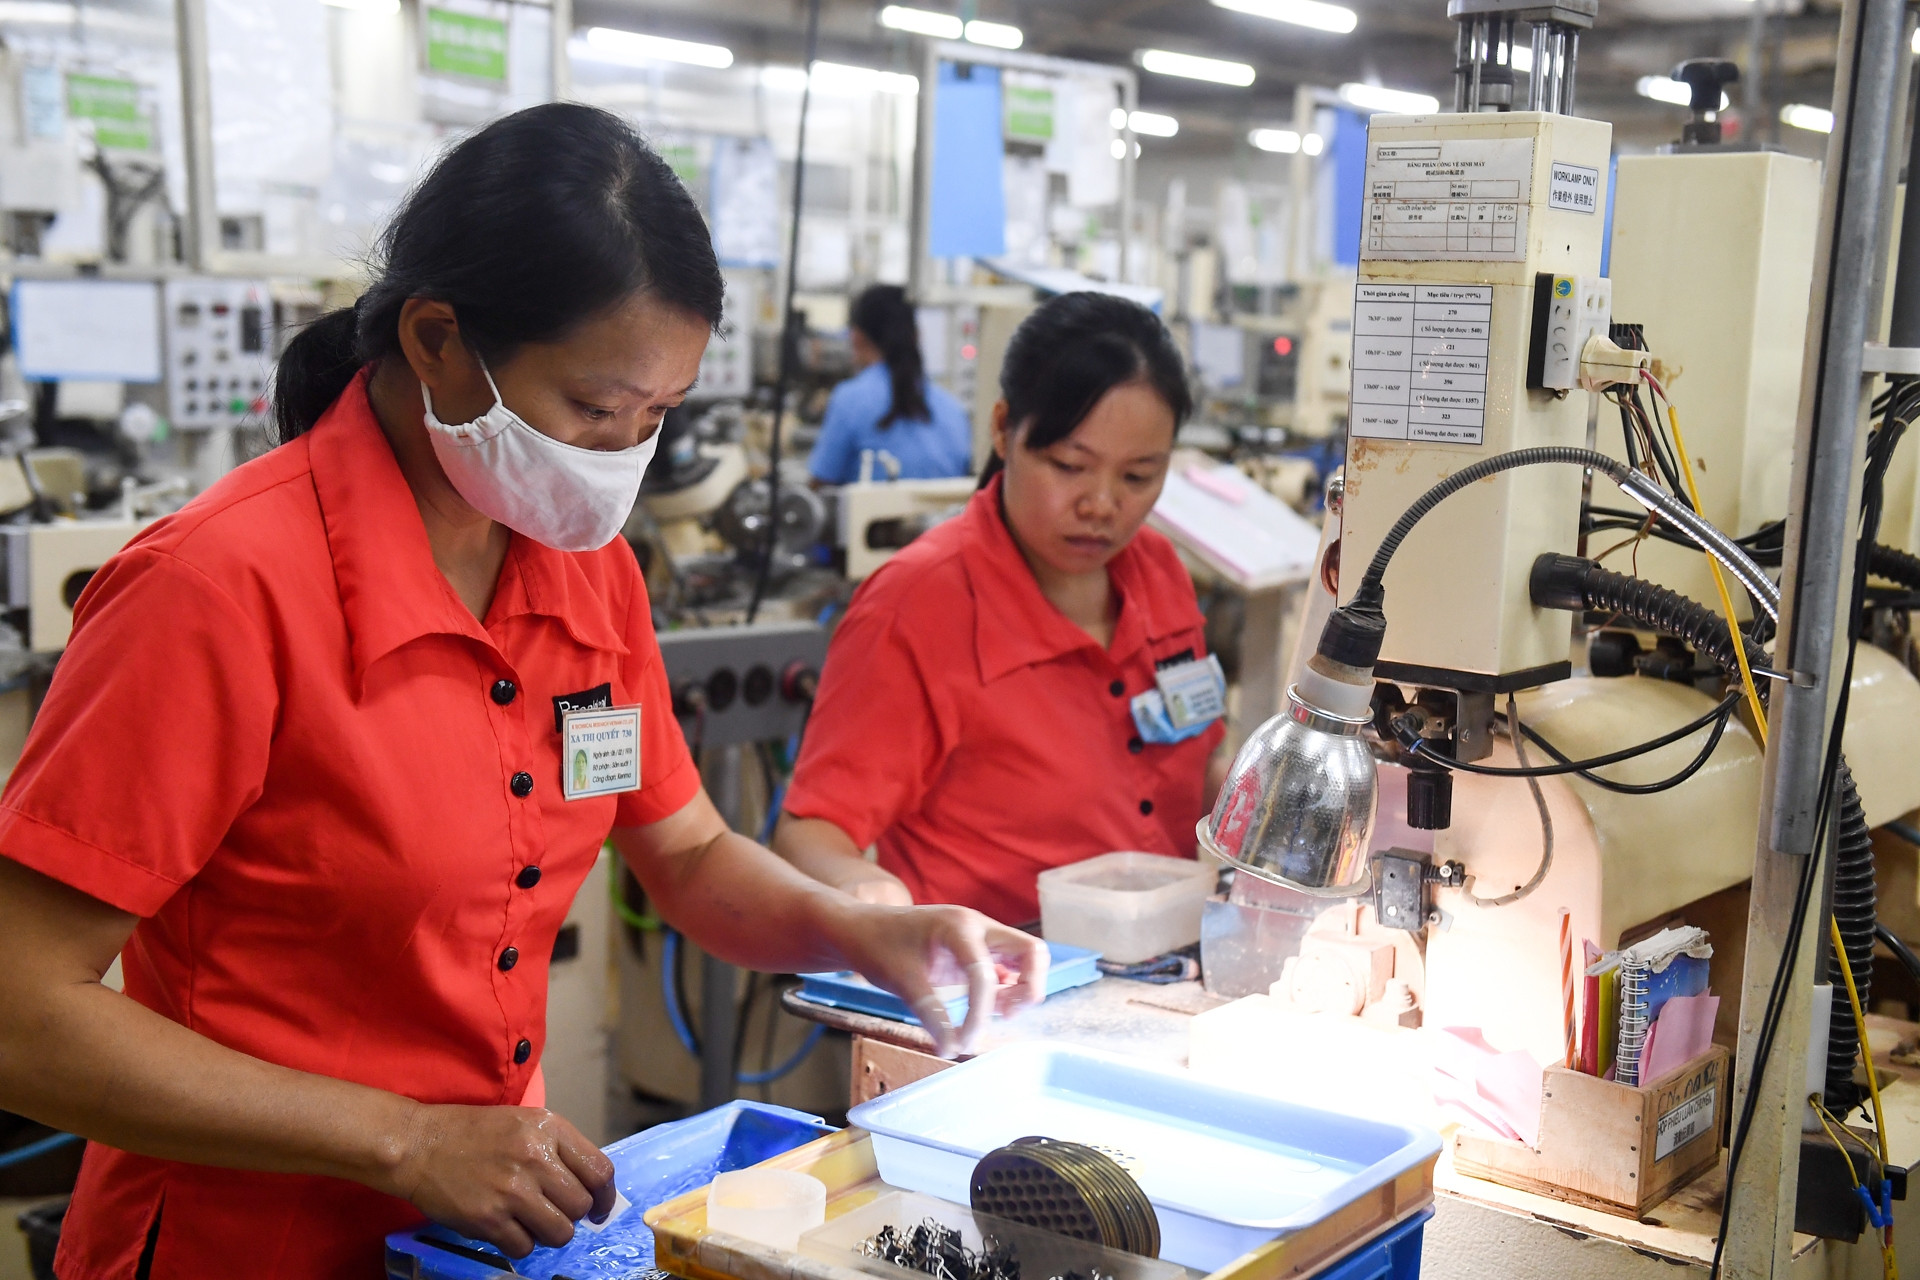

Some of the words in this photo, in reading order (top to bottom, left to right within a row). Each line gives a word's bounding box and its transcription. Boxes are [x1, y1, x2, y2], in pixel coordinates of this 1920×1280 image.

[1554, 170, 1581, 183] WORKLAMP
[1583, 175, 1596, 186] ONLY
[570, 734, 580, 743] XA
[582, 733, 595, 743] THỊ
[596, 728, 619, 742] QUYẾT
[622, 729, 632, 738] 730
[1658, 1119, 1667, 1136] HỘP
[1667, 1111, 1681, 1130] PHIẾU
[1681, 1104, 1694, 1121] LUÂN
